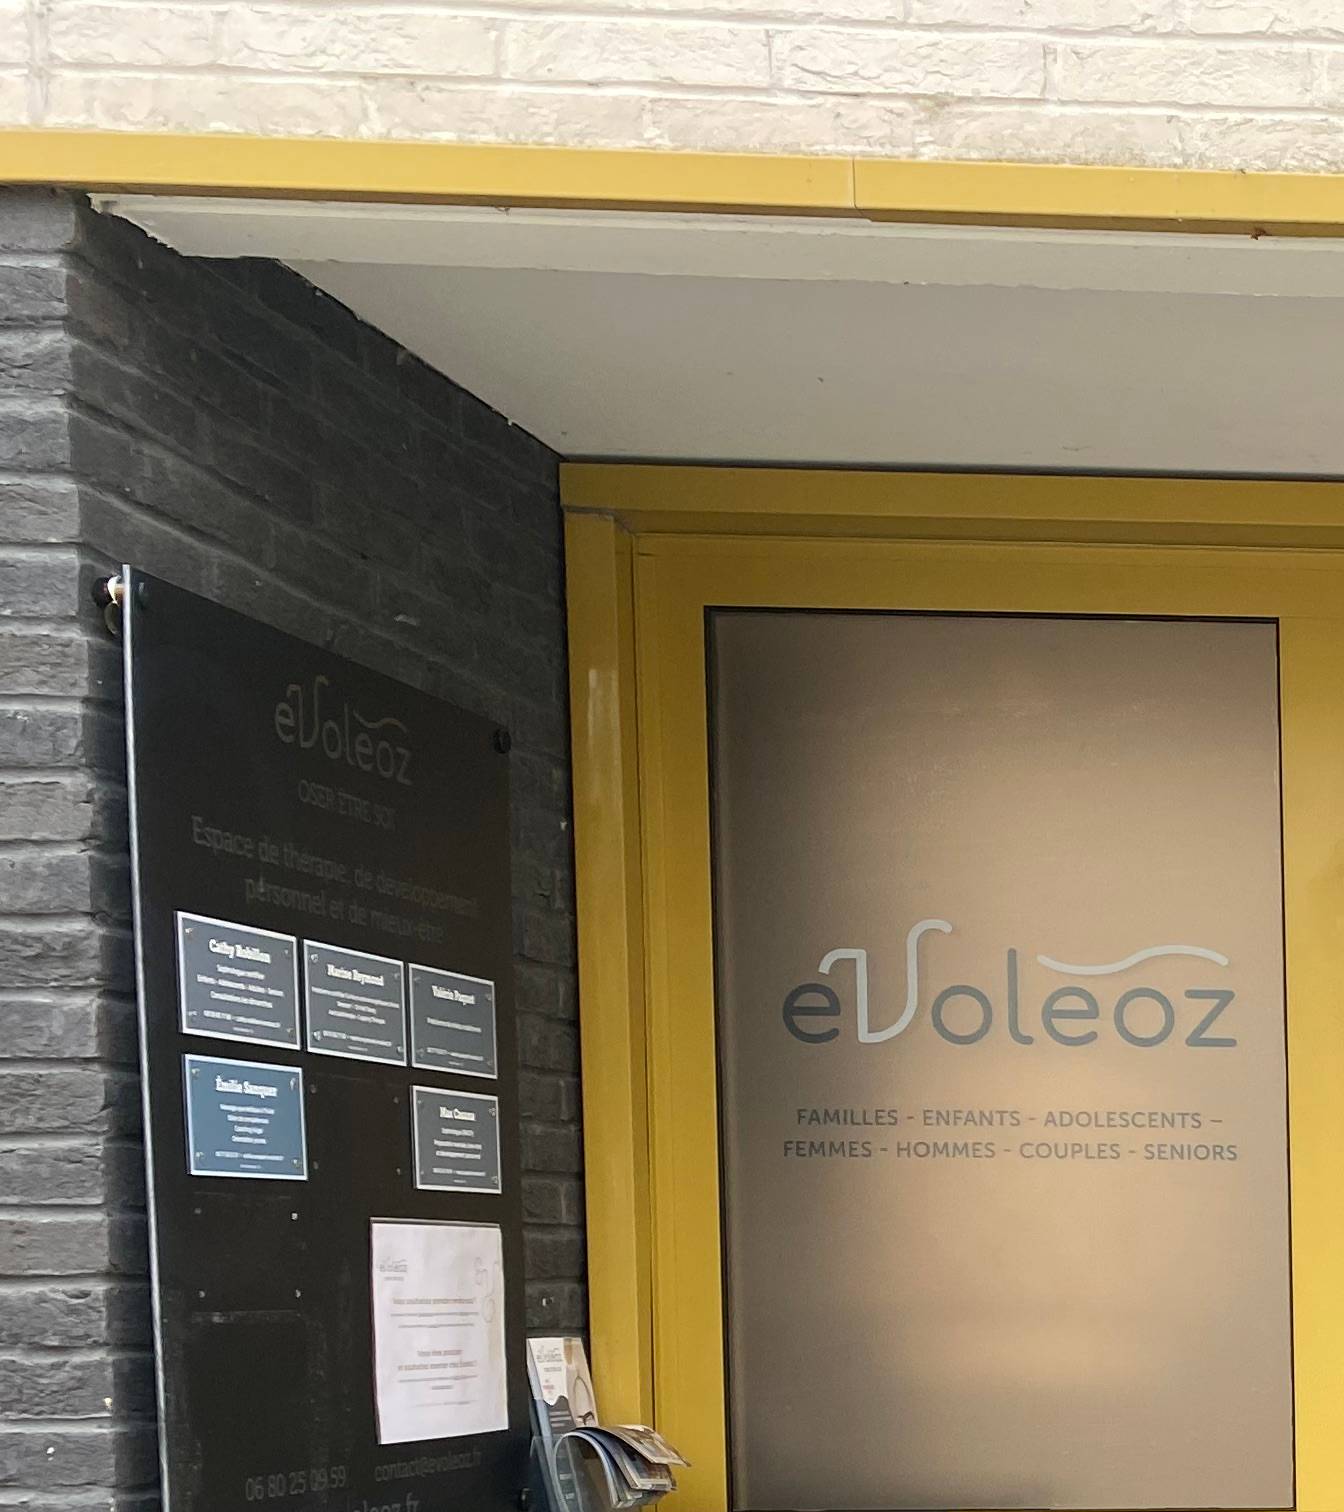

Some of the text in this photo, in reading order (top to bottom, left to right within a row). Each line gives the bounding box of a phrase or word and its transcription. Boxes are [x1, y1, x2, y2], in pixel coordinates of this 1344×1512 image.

[796, 1109, 898, 1127] FAMILLES
[923, 1110, 1021, 1128] ENFANTS
[1044, 1111, 1202, 1129] ADOLESCENTS
[783, 1140, 872, 1158] FEMMES
[897, 1141, 995, 1159] HOMMES
[1019, 1142, 1121, 1160] COUPLES
[1144, 1143, 1238, 1162] SENIORS
